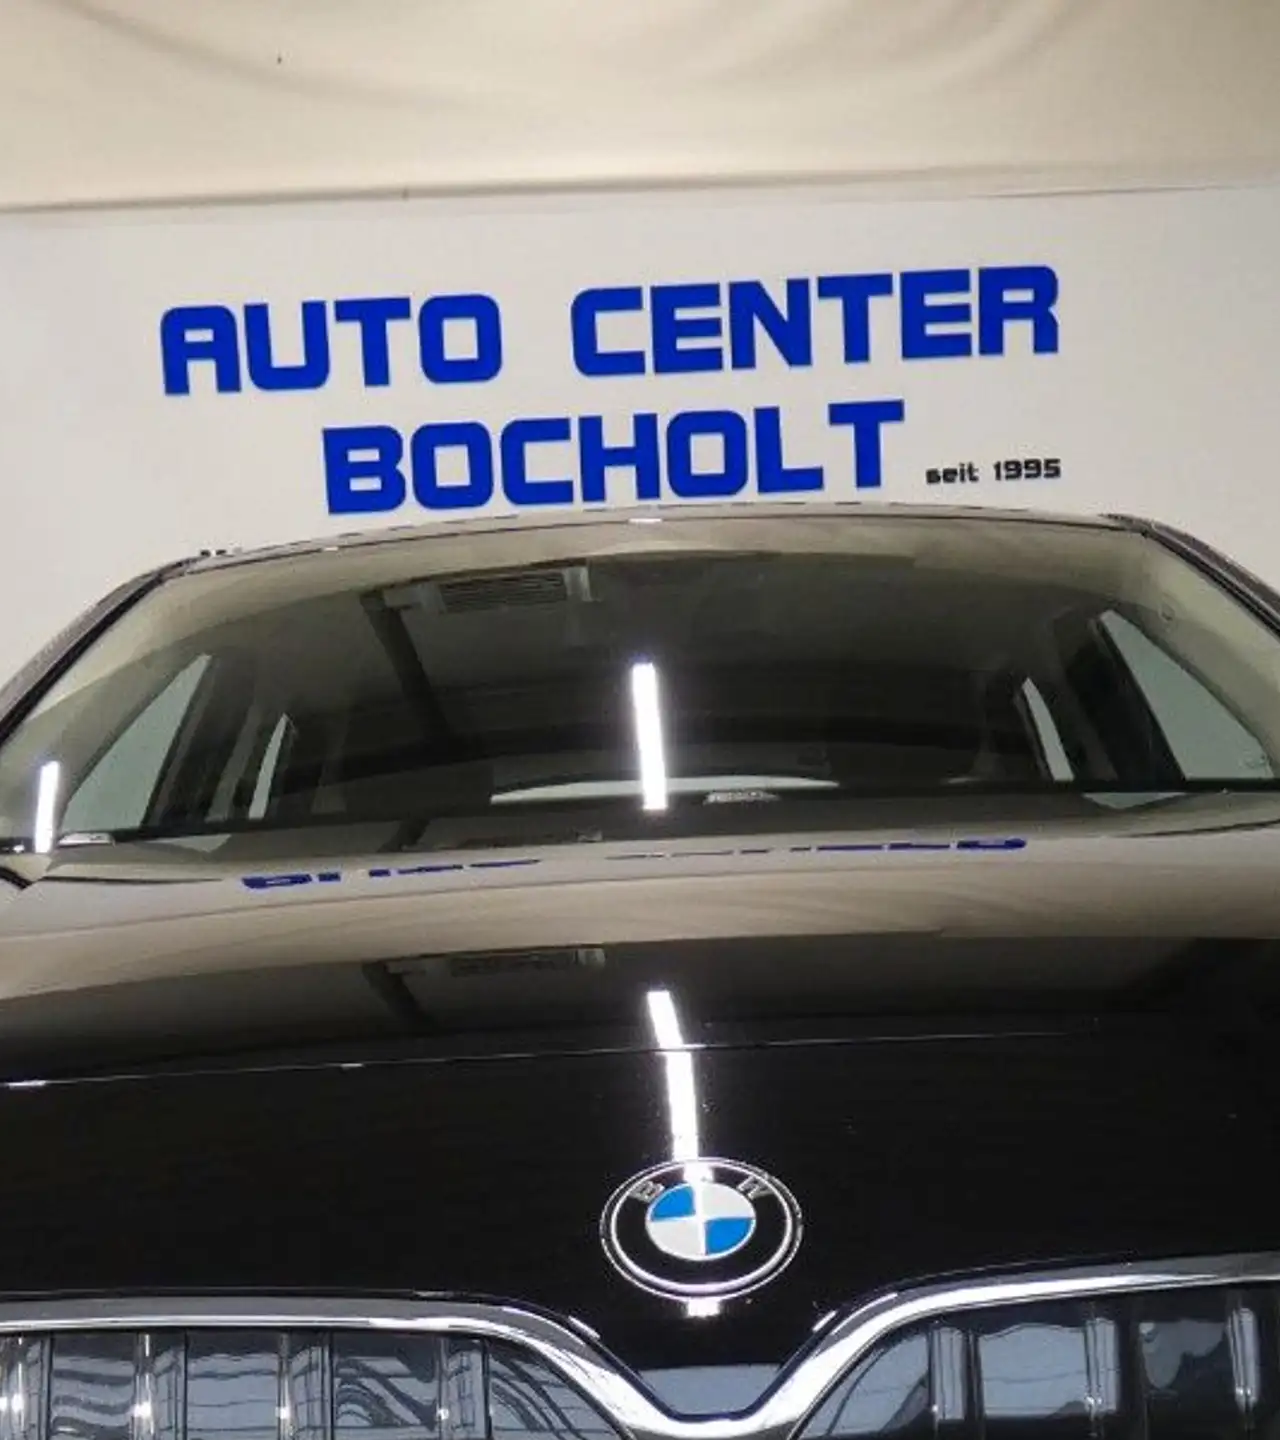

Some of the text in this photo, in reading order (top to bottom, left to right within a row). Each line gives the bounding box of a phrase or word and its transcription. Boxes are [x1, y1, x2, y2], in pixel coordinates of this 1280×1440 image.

[160, 265, 1060, 396] AUTO CENTER
[323, 400, 905, 515] BOCHOLT
[925, 458, 1062, 485] seit 1995
